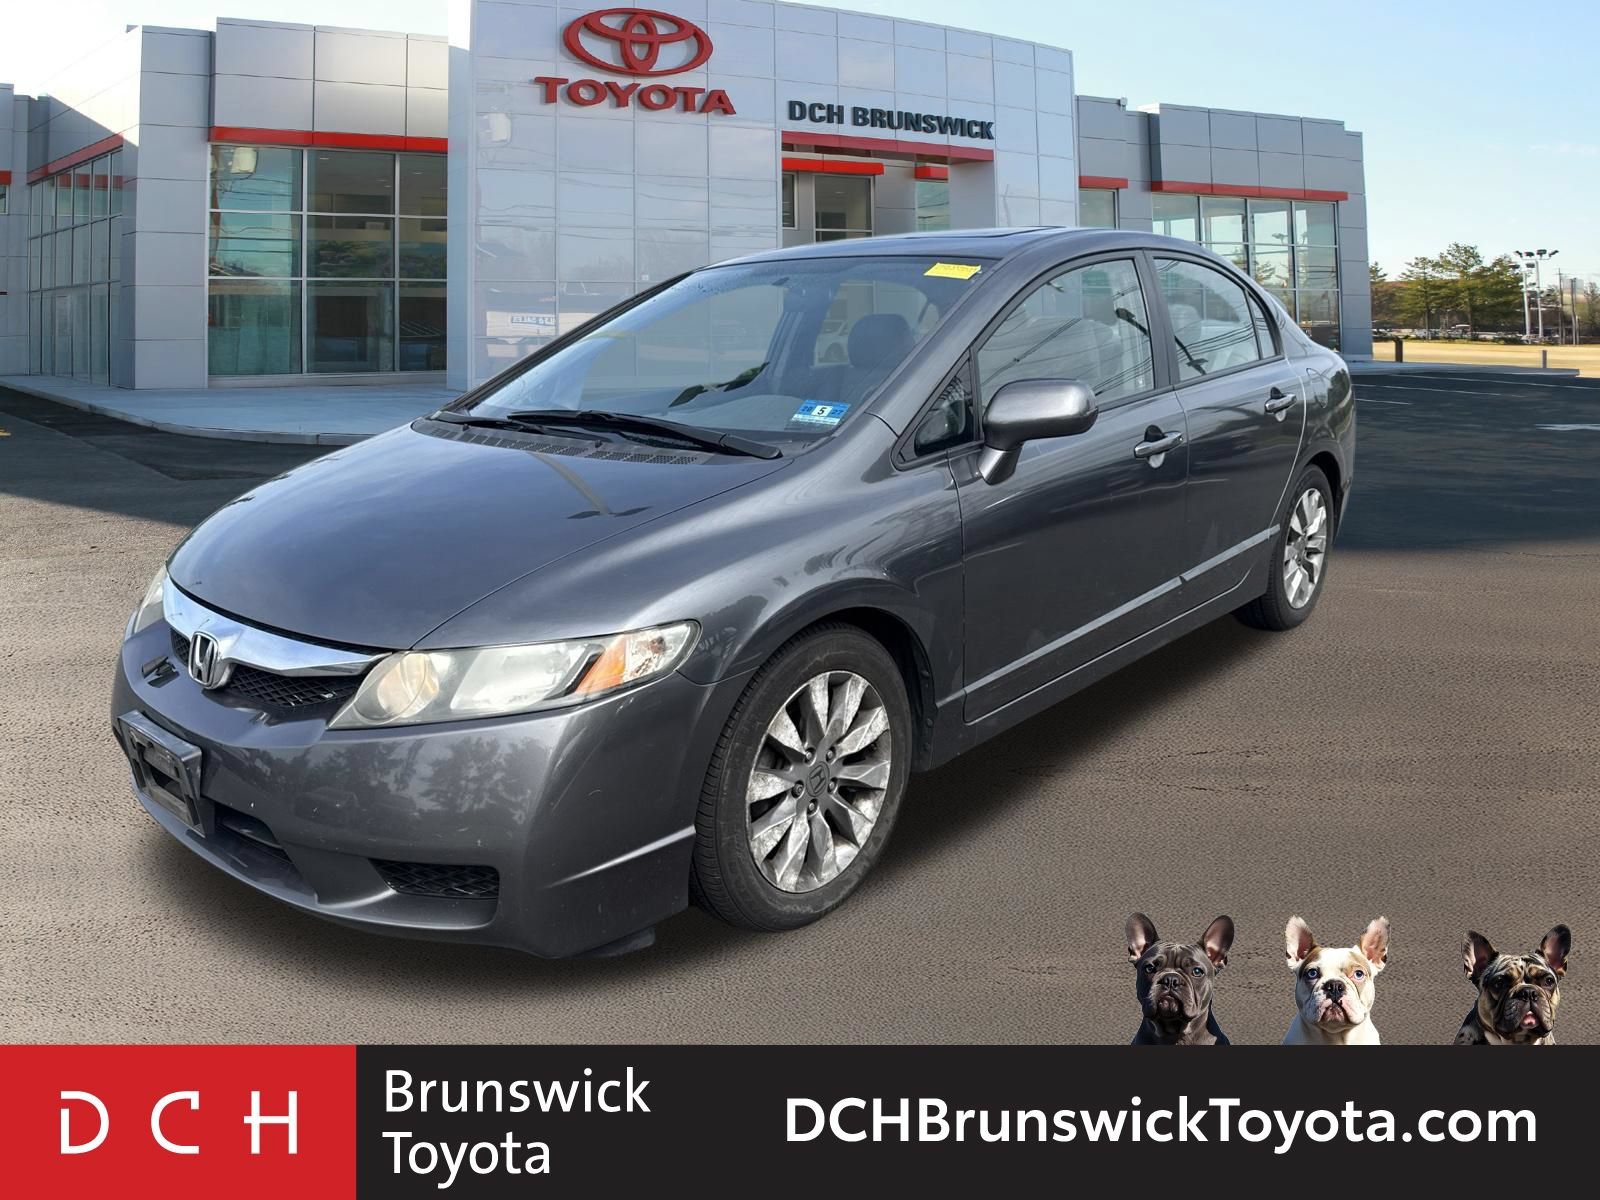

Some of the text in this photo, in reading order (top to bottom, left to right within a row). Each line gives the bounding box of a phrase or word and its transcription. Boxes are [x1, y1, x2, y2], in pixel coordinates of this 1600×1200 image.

[534, 76, 737, 115] TOYOTA
[788, 100, 995, 140] DCH BRUNSWICK
[817, 406, 828, 415] 5
